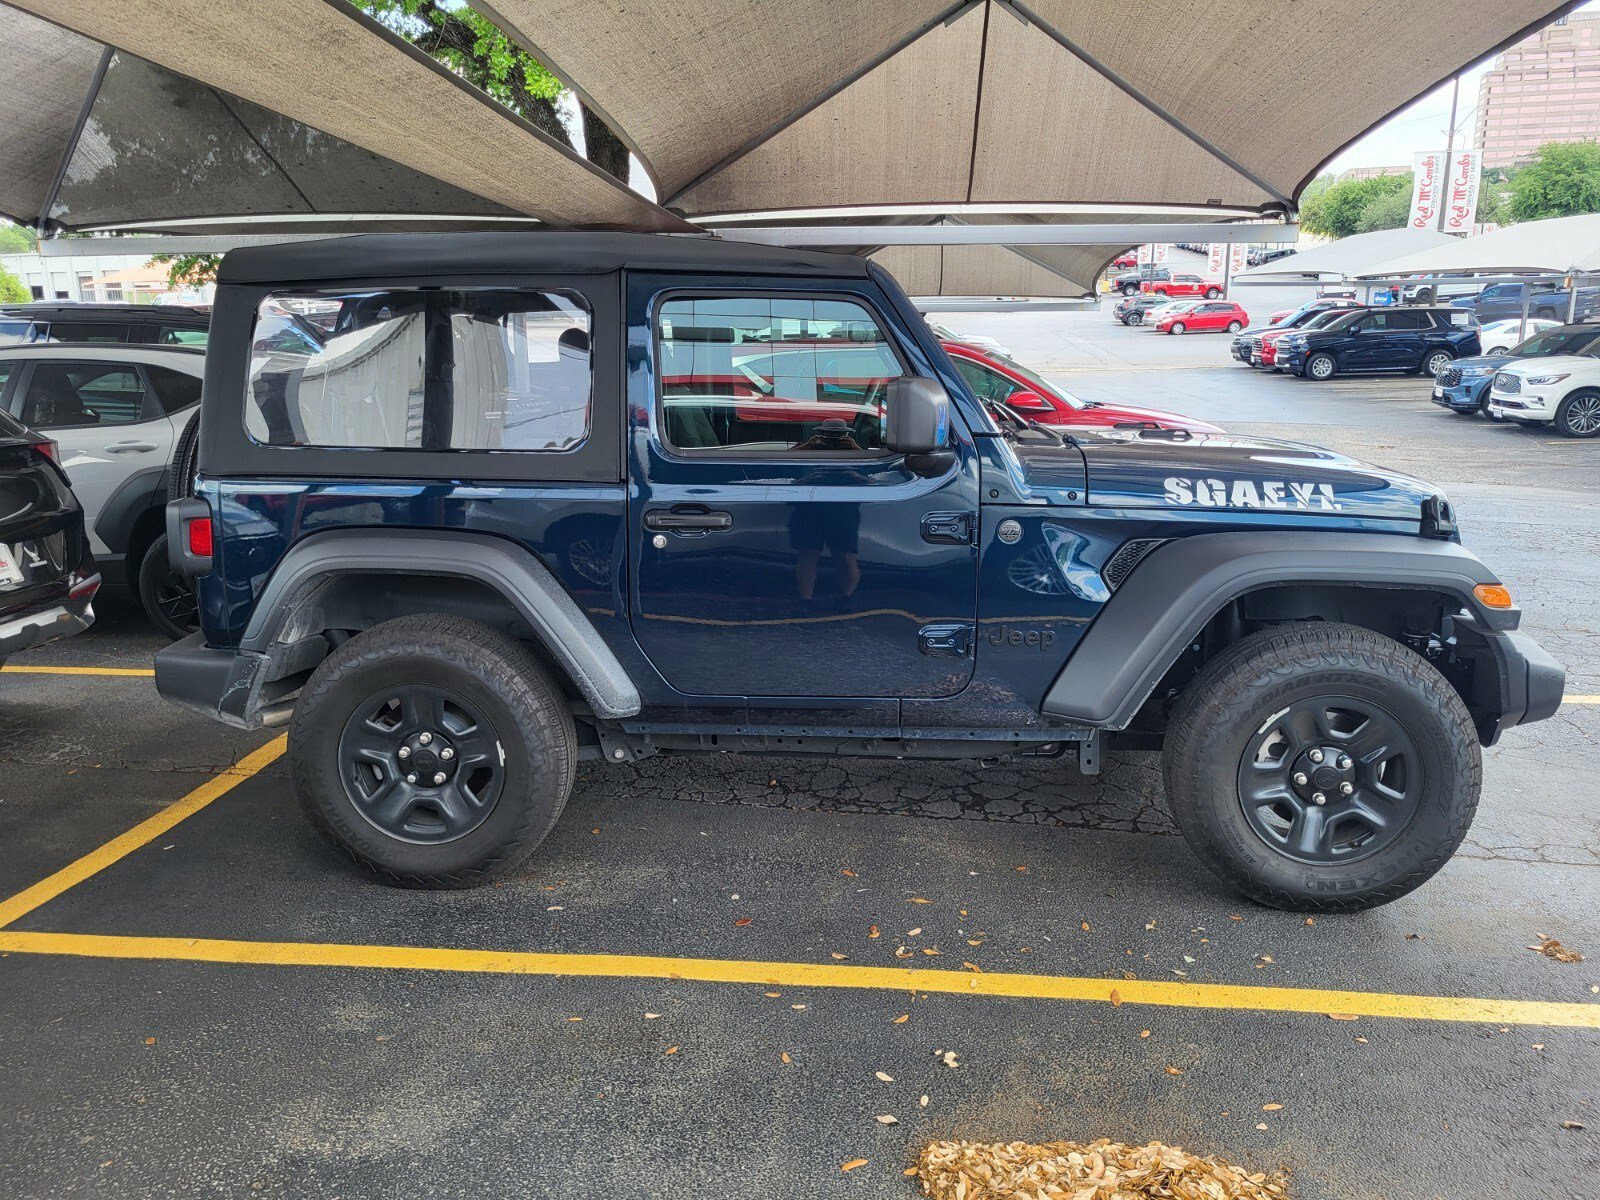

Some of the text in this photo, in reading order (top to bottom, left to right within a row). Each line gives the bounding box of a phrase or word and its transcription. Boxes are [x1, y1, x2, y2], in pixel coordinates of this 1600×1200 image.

[1414, 155, 1435, 228] Red McCombs
[1449, 154, 1471, 228] Red McCombs
[1163, 477, 1342, 511] SGAEYL
[989, 624, 1058, 652] Jeep
